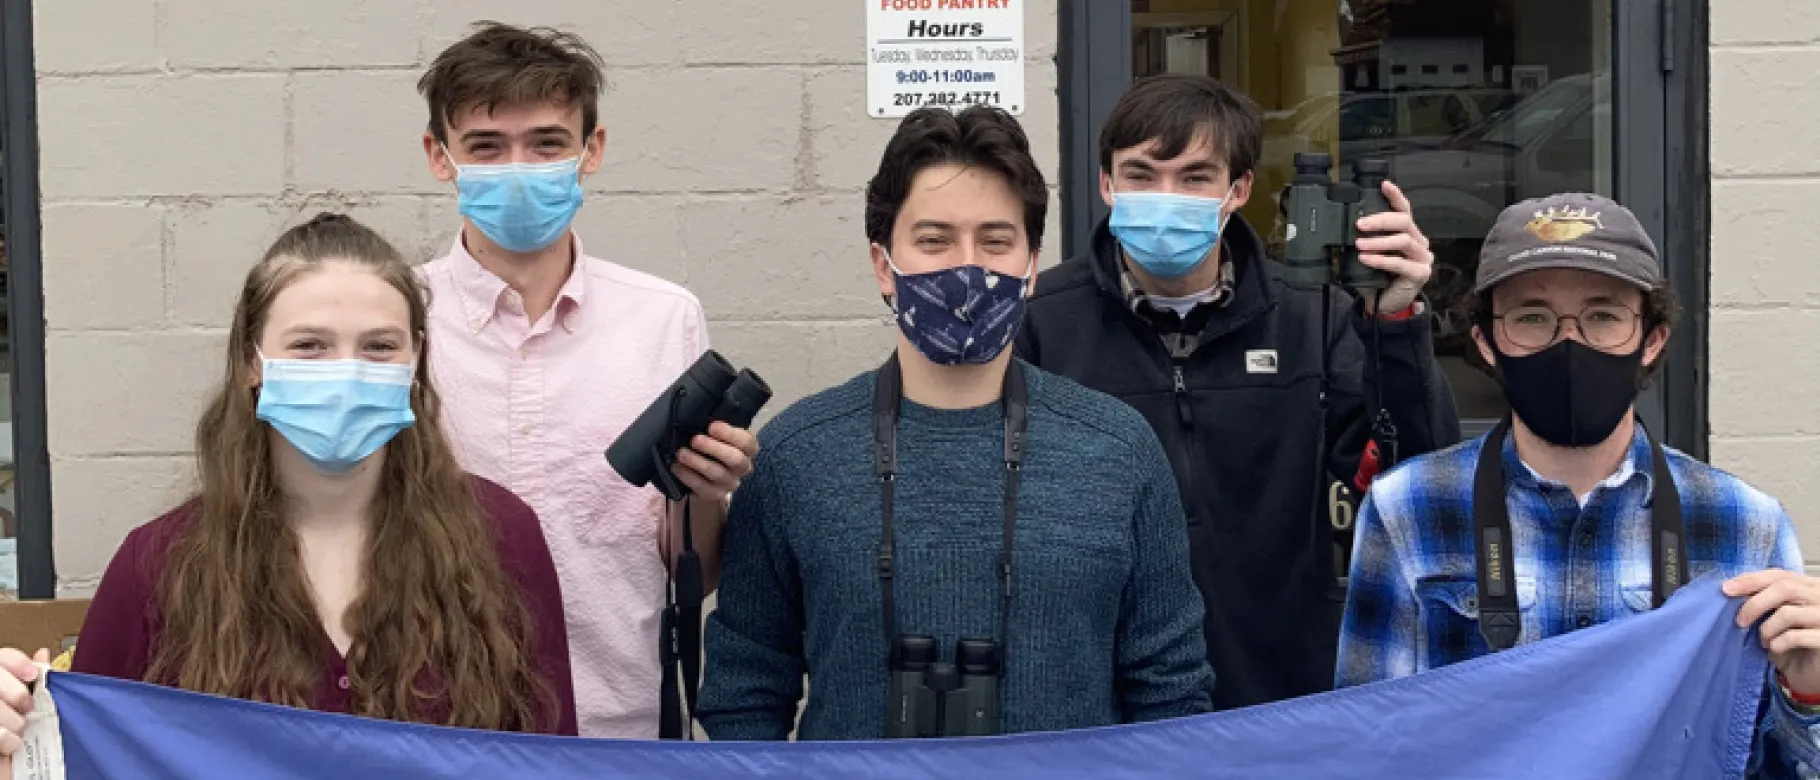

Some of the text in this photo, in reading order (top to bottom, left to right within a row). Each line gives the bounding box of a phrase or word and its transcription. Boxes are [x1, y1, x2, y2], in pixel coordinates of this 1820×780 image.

[881, 0, 1010, 11] FOOD PANTRY
[907, 20, 984, 37] Hours
[895, 69, 996, 83] 9:00-11:00am
[1329, 480, 1353, 530] 6
